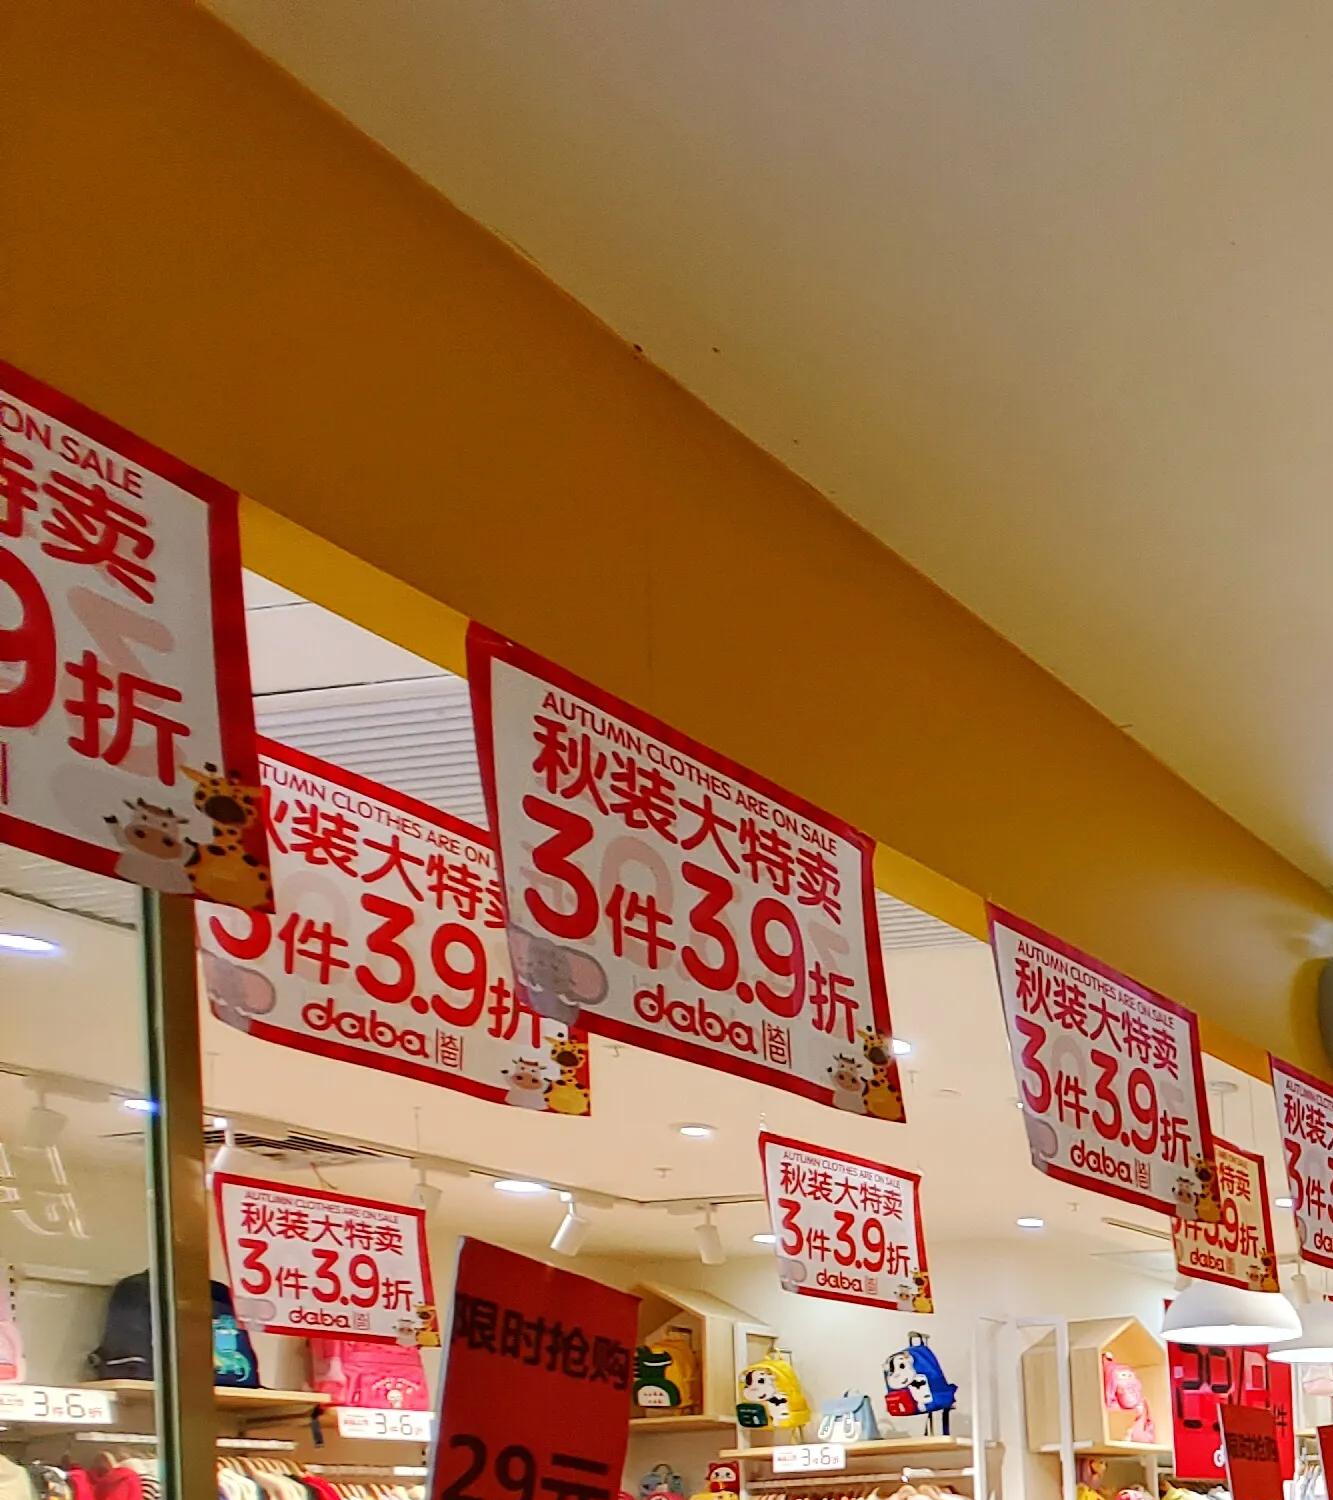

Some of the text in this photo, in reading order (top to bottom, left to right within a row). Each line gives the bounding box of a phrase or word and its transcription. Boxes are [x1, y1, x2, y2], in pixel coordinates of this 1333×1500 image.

[1, 404, 143, 499] ON SALE
[542, 692, 837, 856] AUTUMN CLOTHES ARE ON SALE
[260, 763, 490, 867] TUMN CLOTHES ARE ON
[533, 715, 841, 925] 秋装大特卖
[522, 795, 860, 1044] 3件3.9折
[301, 998, 429, 1059] daba
[634, 984, 757, 1055] daba
[1015, 958, 1178, 1080] 秋装大特卖
[1015, 1016, 1192, 1169] 3件3.9折
[780, 1162, 903, 1220] 秋装大特卖
[1071, 1139, 1133, 1185] daba
[240, 1202, 403, 1256] 秋装大特卖
[778, 1198, 911, 1278] 3件3.9折
[238, 1238, 414, 1312] 3件3.9折
[816, 1269, 863, 1292] daba
[288, 1306, 350, 1329] daba
[453, 1293, 630, 1391] 限时抢购
